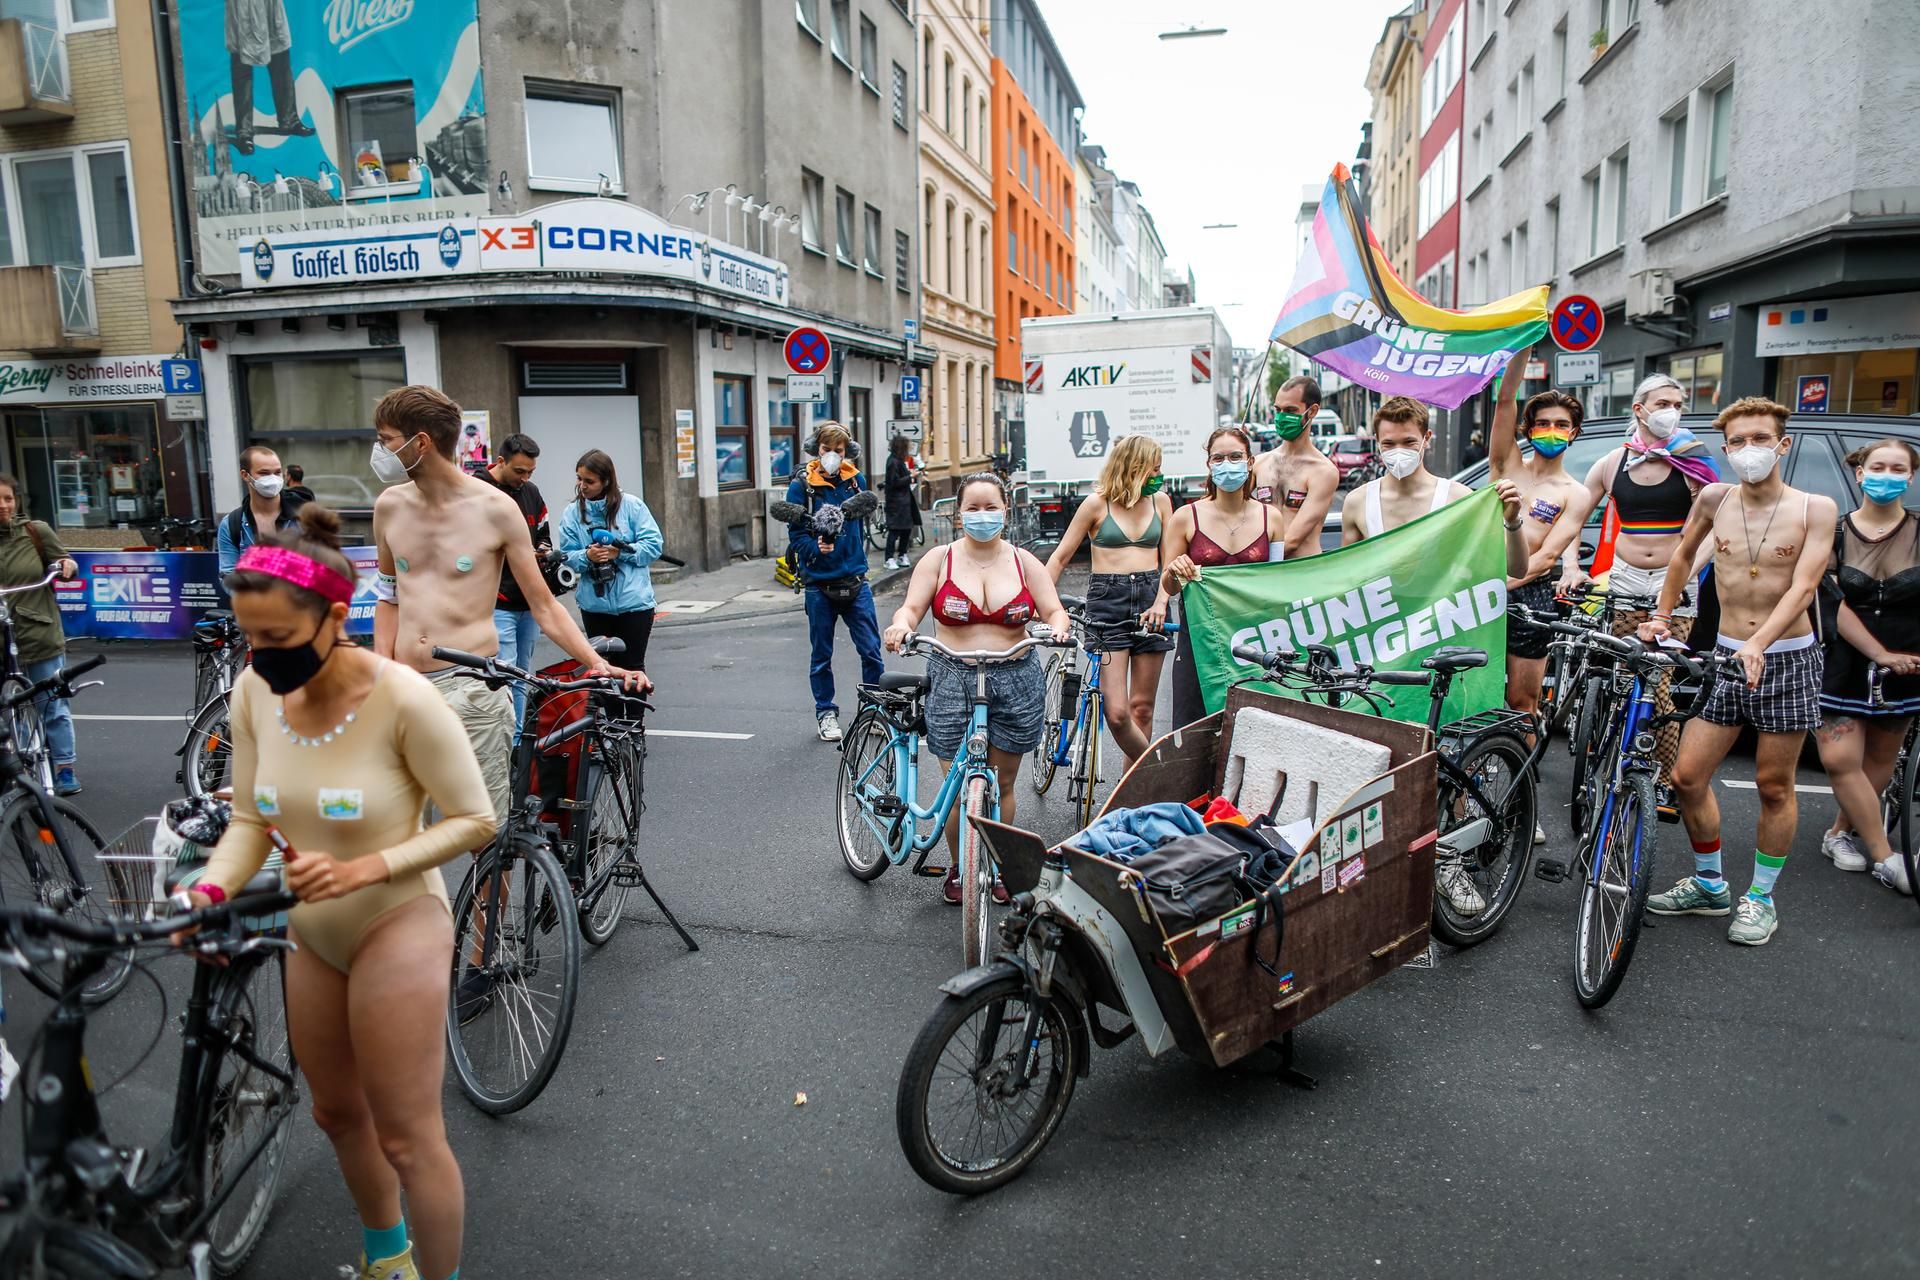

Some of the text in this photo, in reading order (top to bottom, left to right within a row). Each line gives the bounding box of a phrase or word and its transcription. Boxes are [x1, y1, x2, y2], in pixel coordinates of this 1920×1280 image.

[292, 243, 420, 279] Gaffel Kölsch
[548, 226, 694, 262] CORNER
[718, 259, 770, 296] Gaffel Kölsch
[1332, 290, 1452, 351] GRÜNE
[68, 384, 89, 397] FÜR
[1061, 364, 1126, 388] AKTIV
[1363, 367, 1390, 383] Köln
[1077, 440, 1103, 456] AG
[93, 577, 172, 603] EXILE
[1230, 575, 1400, 667] GRÜNE
[1335, 577, 1508, 673] UGEND
